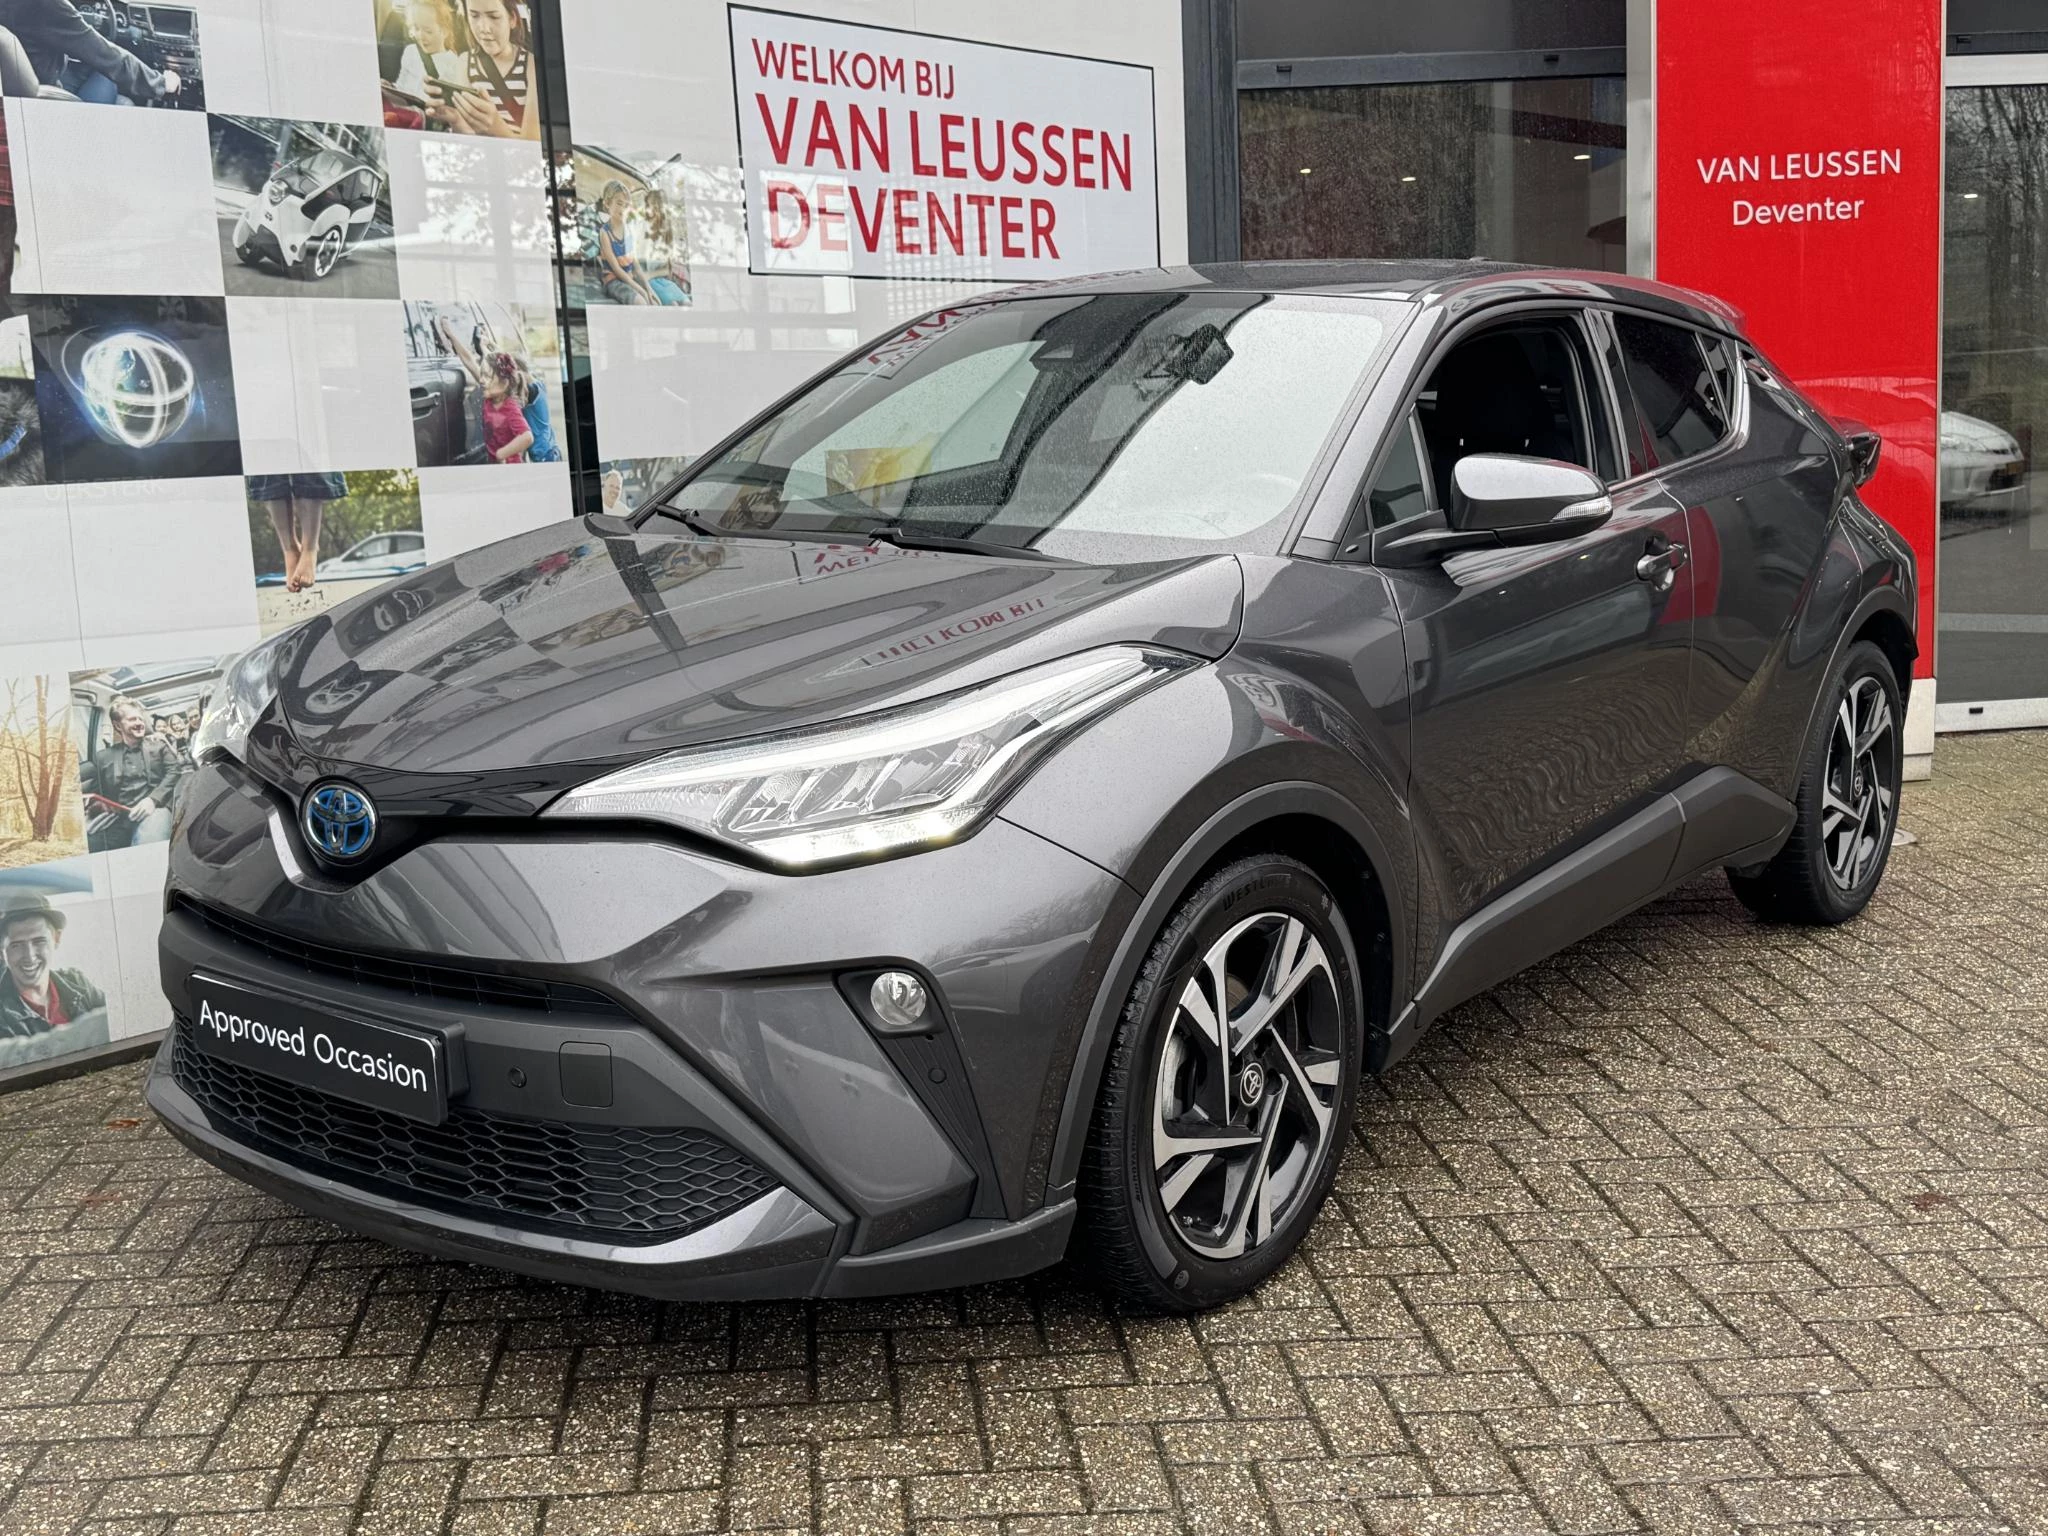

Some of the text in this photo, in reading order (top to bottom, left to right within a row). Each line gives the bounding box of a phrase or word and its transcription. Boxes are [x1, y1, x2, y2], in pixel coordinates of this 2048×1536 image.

[752, 38, 955, 100] WELKOM BIJ
[755, 92, 1132, 192] VAN LEUSSEN
[1696, 148, 1901, 184] VAN LEUSSEN
[767, 180, 1060, 260] DEVENTER
[1732, 196, 1865, 226] Deventer
[199, 999, 428, 1093] Approved Occasion
